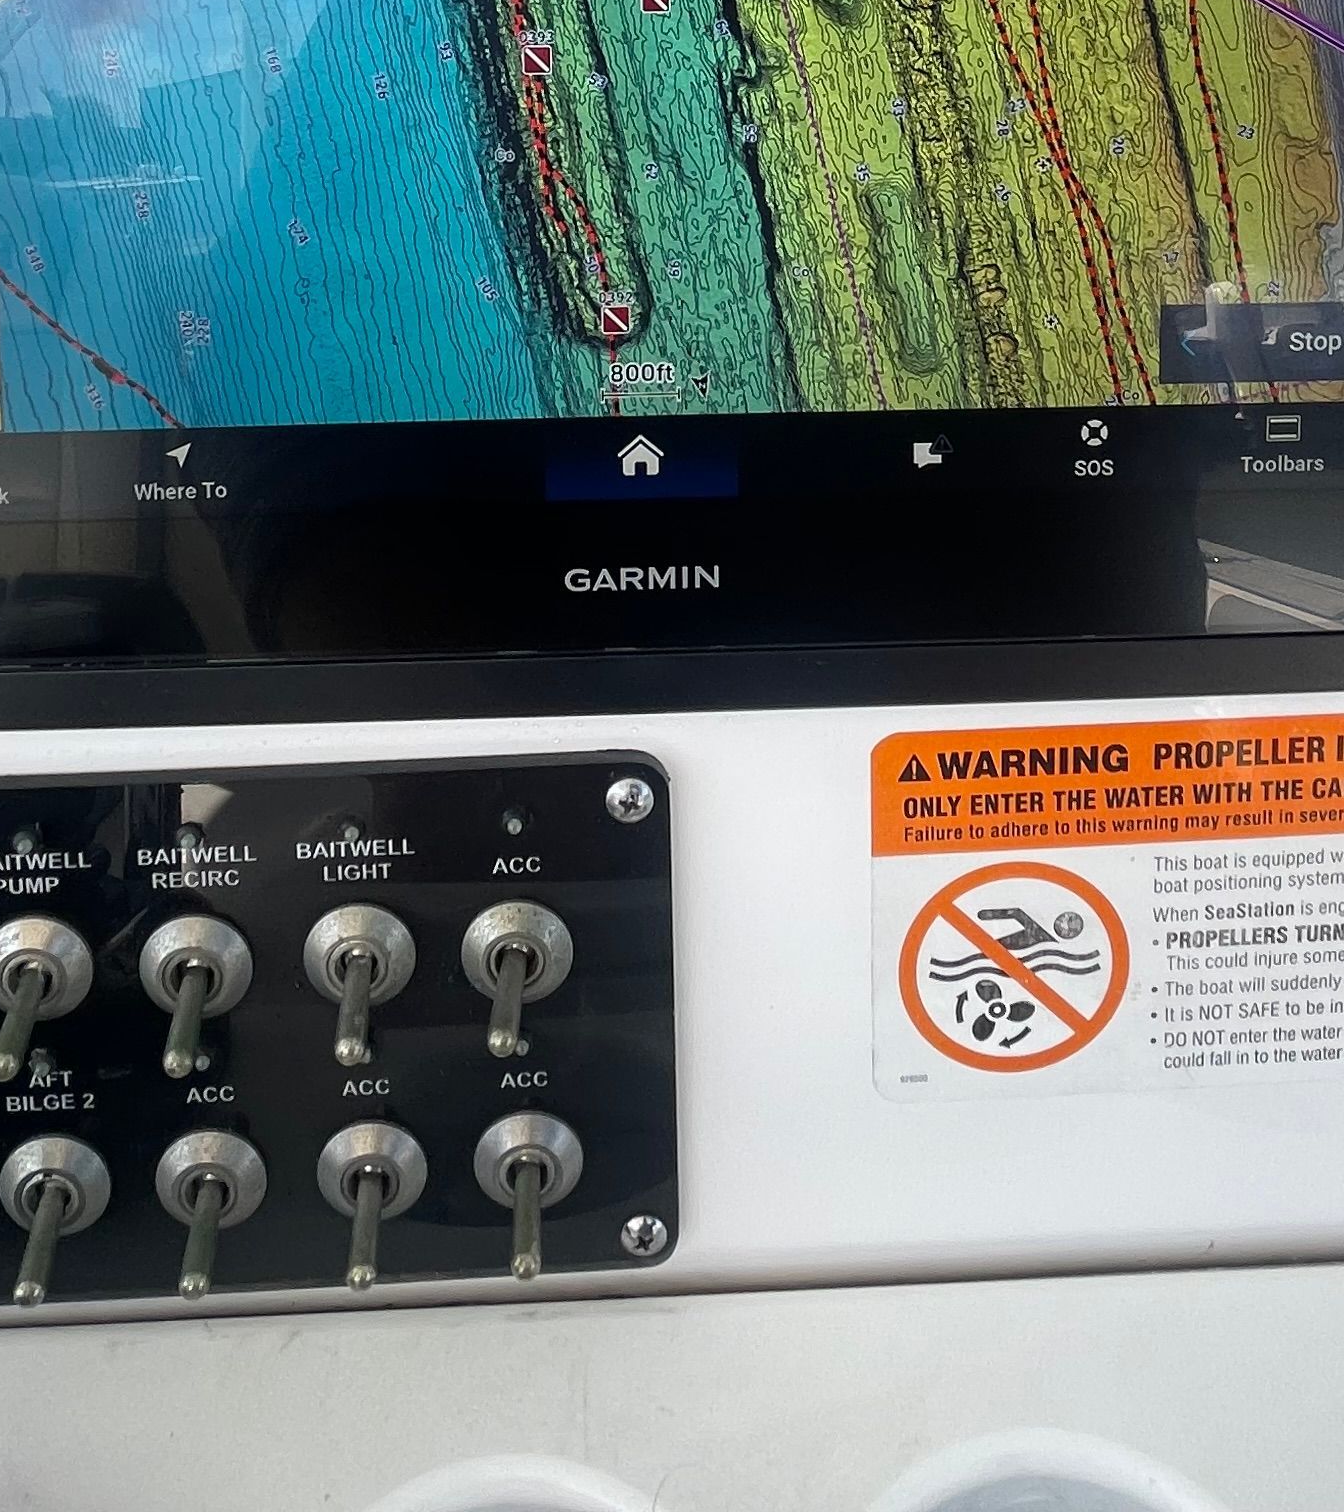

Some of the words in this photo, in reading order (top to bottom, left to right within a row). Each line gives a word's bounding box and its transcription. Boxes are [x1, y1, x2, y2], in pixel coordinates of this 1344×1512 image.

[1237, 125, 1255, 140] 23
[1112, 137, 1125, 155] 20
[475, 276, 499, 304] 105
[598, 292, 633, 303] 0392
[1288, 332, 1343, 353] Stop
[610, 364, 674, 383] 800ft
[1074, 459, 1114, 477] SOS
[1240, 454, 1325, 474] Toolbars
[134, 481, 197, 502] Where
[200, 480, 227, 500] To
[563, 564, 721, 593] GARMIN
[937, 744, 1129, 780] WARNING
[1153, 735, 1325, 770] PROPELLER
[904, 795, 962, 819] ONLY
[970, 792, 1045, 816] ENTER
[1053, 789, 1097, 812] THE
[1106, 785, 1185, 809] WATER
[1193, 782, 1252, 805] WITH
[1260, 778, 1304, 801] THE
[904, 824, 963, 842] Failure
[969, 824, 984, 839] to
[990, 821, 1049, 838] adhere
[1055, 821, 1070, 835] to
[1076, 817, 1106, 834] this
[1112, 813, 1178, 835] warning
[1184, 814, 1219, 831] may
[1225, 809, 1273, 827] result
[1279, 808, 1294, 824] in
[137, 845, 257, 867] BAITWELL
[296, 838, 416, 860] BAITWELL
[492, 856, 542, 875] ACC
[1154, 855, 1188, 872] This
[1193, 853, 1229, 870] boat
[1233, 851, 1247, 869] is
[1252, 848, 1325, 869] equipped
[151, 869, 241, 890] RECIRC
[323, 862, 392, 883] LIGHT
[1154, 876, 1188, 894] boat
[1194, 873, 1282, 894] positioning
[1153, 905, 1199, 923] When
[1205, 901, 1295, 921] SeaStation
[1300, 898, 1314, 915] is
[1166, 926, 1288, 949] PROPELLERS
[1167, 954, 1200, 971] This
[1205, 952, 1249, 970] could
[1254, 950, 1298, 969] injure
[1165, 980, 1194, 997] The
[1199, 979, 1234, 995] boat
[1239, 976, 1266, 993] will
[1270, 973, 1342, 993] suddenly
[1165, 1006, 1175, 1023] It
[1180, 1005, 1193, 1022] is
[1199, 1003, 1233, 1020] NOT
[1238, 1001, 1281, 1019] SAFE
[1285, 1000, 1301, 1016] to
[1306, 998, 1325, 1015] be
[1330, 997, 1344, 1014] in
[1164, 1030, 1187, 1048] DO
[1192, 1029, 1226, 1046] NOT
[1230, 1028, 1268, 1044] enter
[1273, 1026, 1296, 1042] the
[1301, 1024, 1342, 1041] water
[1164, 1050, 1205, 1070] could
[1209, 1049, 1232, 1067] fall
[1236, 1048, 1250, 1065] in
[1254, 1047, 1269, 1064] to
[1273, 1046, 1297, 1064] the
[1301, 1045, 1344, 1062] water
[28, 1070, 73, 1089] AFT
[342, 1078, 390, 1097] ACC
[500, 1070, 549, 1089] ACC
[5, 1094, 76, 1113] BILGE
[81, 1093, 96, 1110] 2
[186, 1085, 235, 1104] ACC
